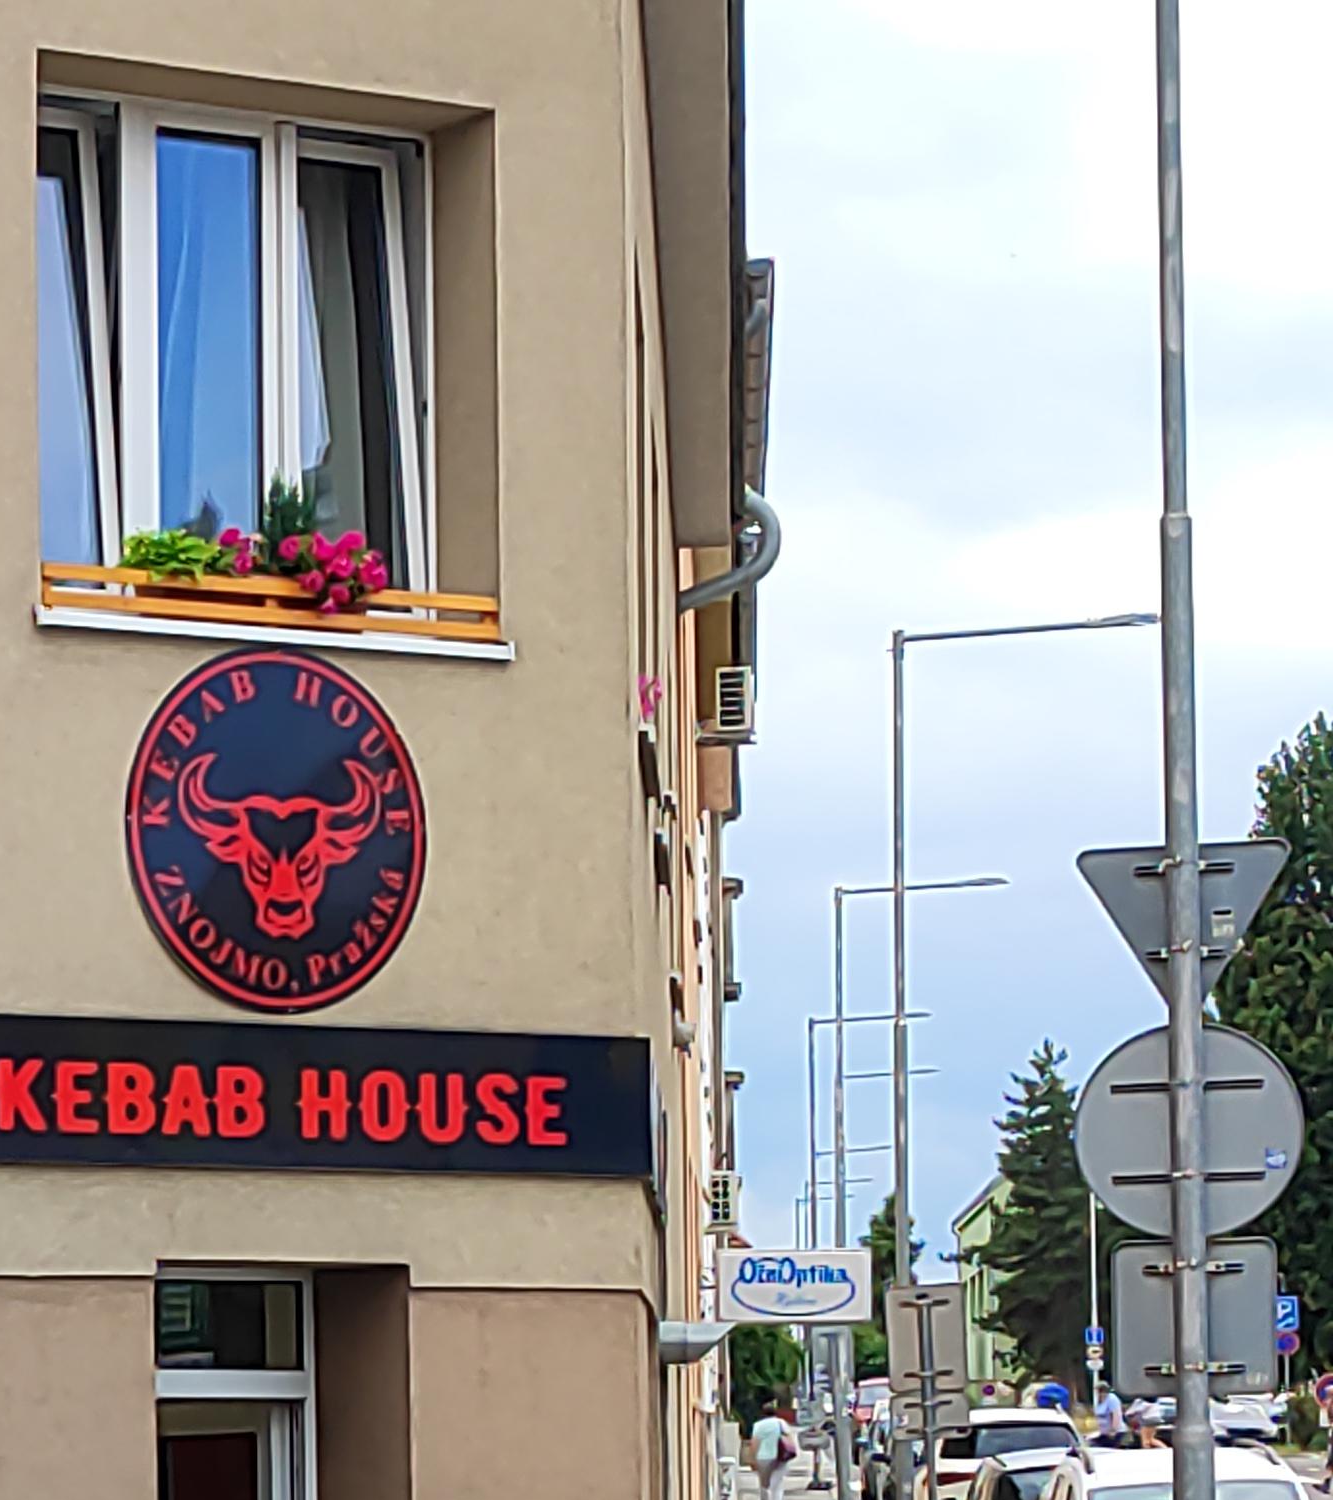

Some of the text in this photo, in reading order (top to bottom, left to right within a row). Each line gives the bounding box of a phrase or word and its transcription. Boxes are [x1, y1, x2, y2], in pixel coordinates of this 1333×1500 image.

[143, 669, 411, 836] KEBAB HOUSE
[298, 1067, 568, 1146] HOUSE
